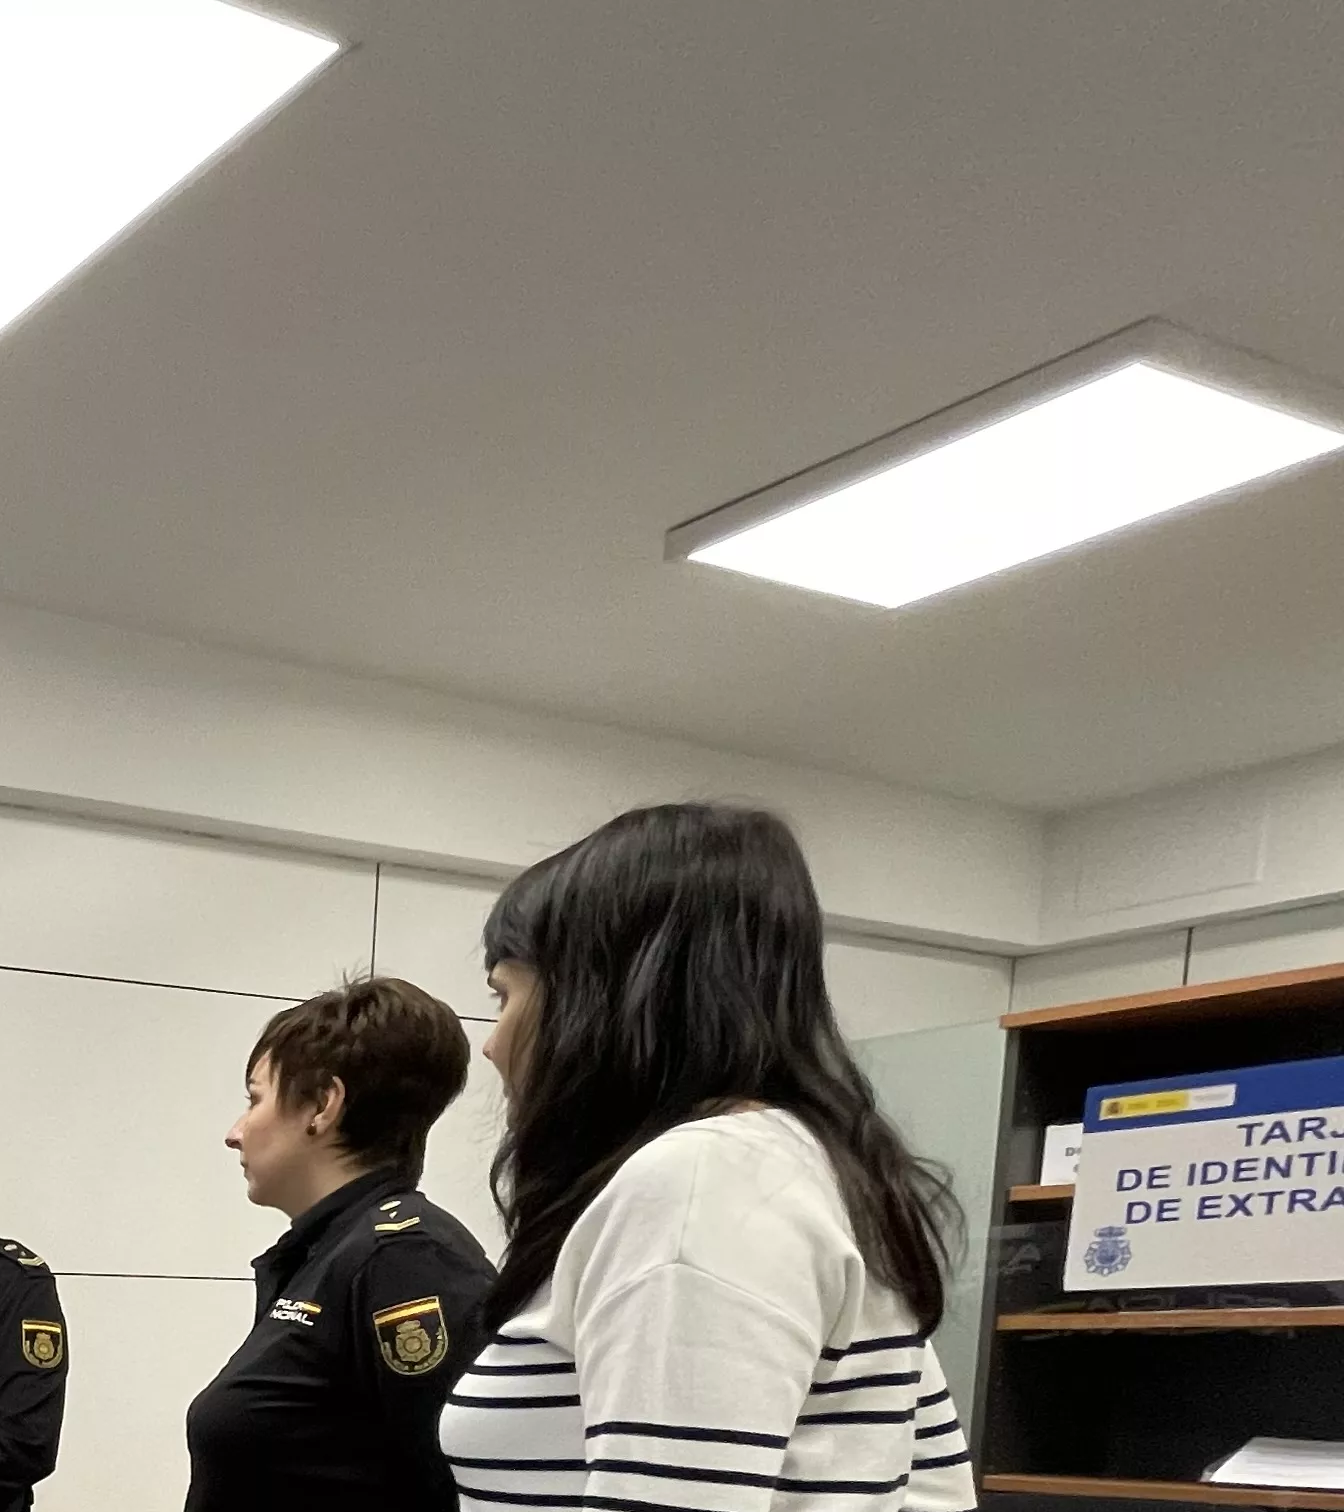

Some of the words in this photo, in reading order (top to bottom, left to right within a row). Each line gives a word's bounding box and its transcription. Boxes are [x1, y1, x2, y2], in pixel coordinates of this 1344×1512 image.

[1116, 1165, 1172, 1192] DE
[1187, 1150, 1344, 1187] IDENTI
[1125, 1198, 1182, 1225] DE
